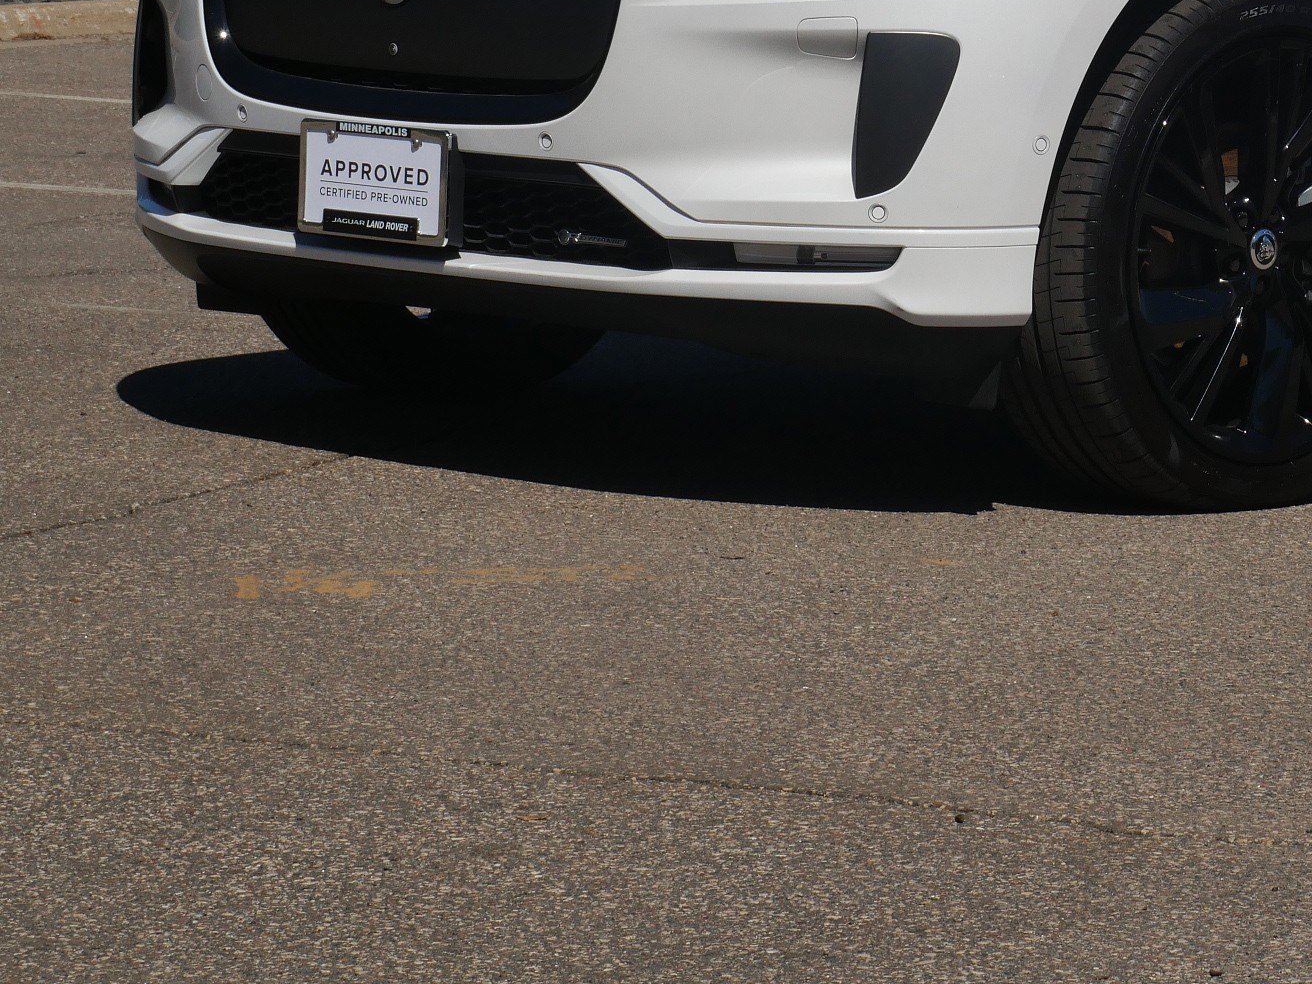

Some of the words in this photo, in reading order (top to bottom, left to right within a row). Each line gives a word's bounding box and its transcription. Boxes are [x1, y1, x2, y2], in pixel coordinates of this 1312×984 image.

[339, 122, 408, 137] MINNEAPOLIS
[320, 158, 429, 186] APPROVED
[319, 186, 368, 201] CERTIFIED
[370, 191, 428, 207] PRE-OWNED
[331, 217, 366, 226] JAGUAR
[366, 219, 384, 229] LAND
[385, 221, 409, 232] ROVER
